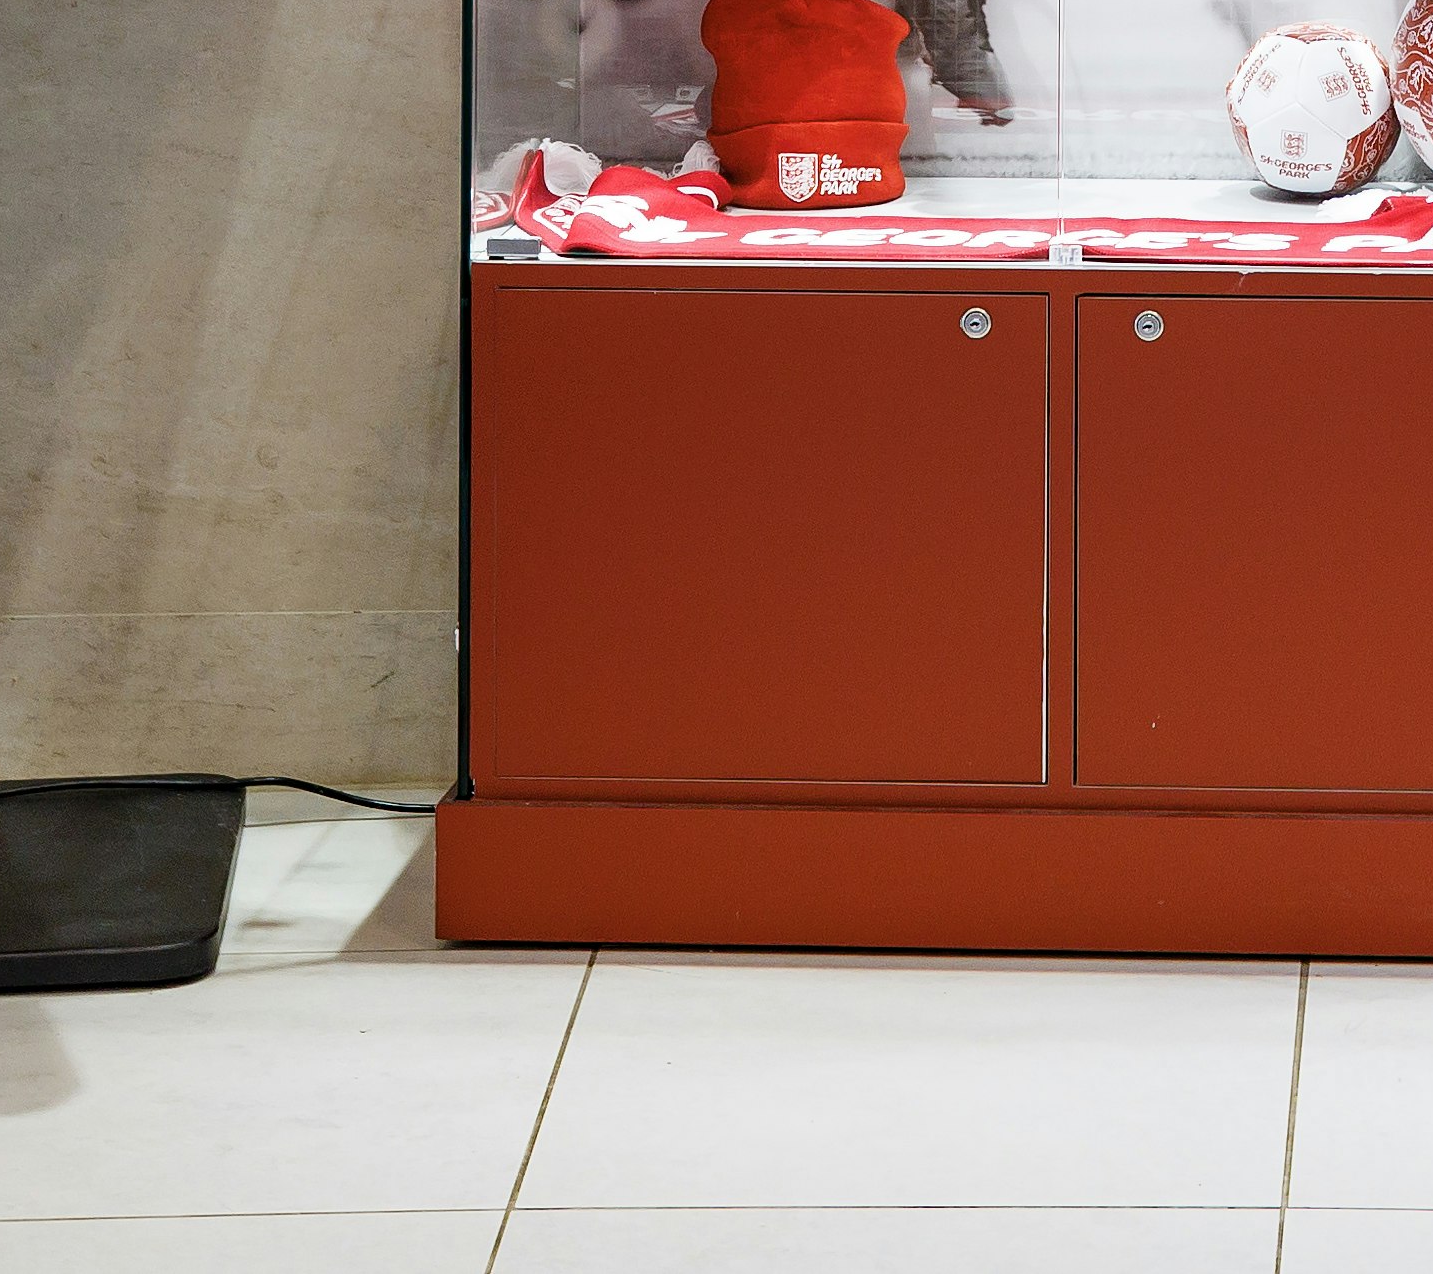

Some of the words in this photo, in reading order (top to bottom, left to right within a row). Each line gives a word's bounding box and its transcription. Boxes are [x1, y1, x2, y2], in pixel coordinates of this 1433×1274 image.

[1274, 159, 1332, 171] GEORGE'S
[820, 168, 882, 182] GEORGE'S
[1278, 168, 1311, 179] PARK
[820, 181, 859, 195] PARK
